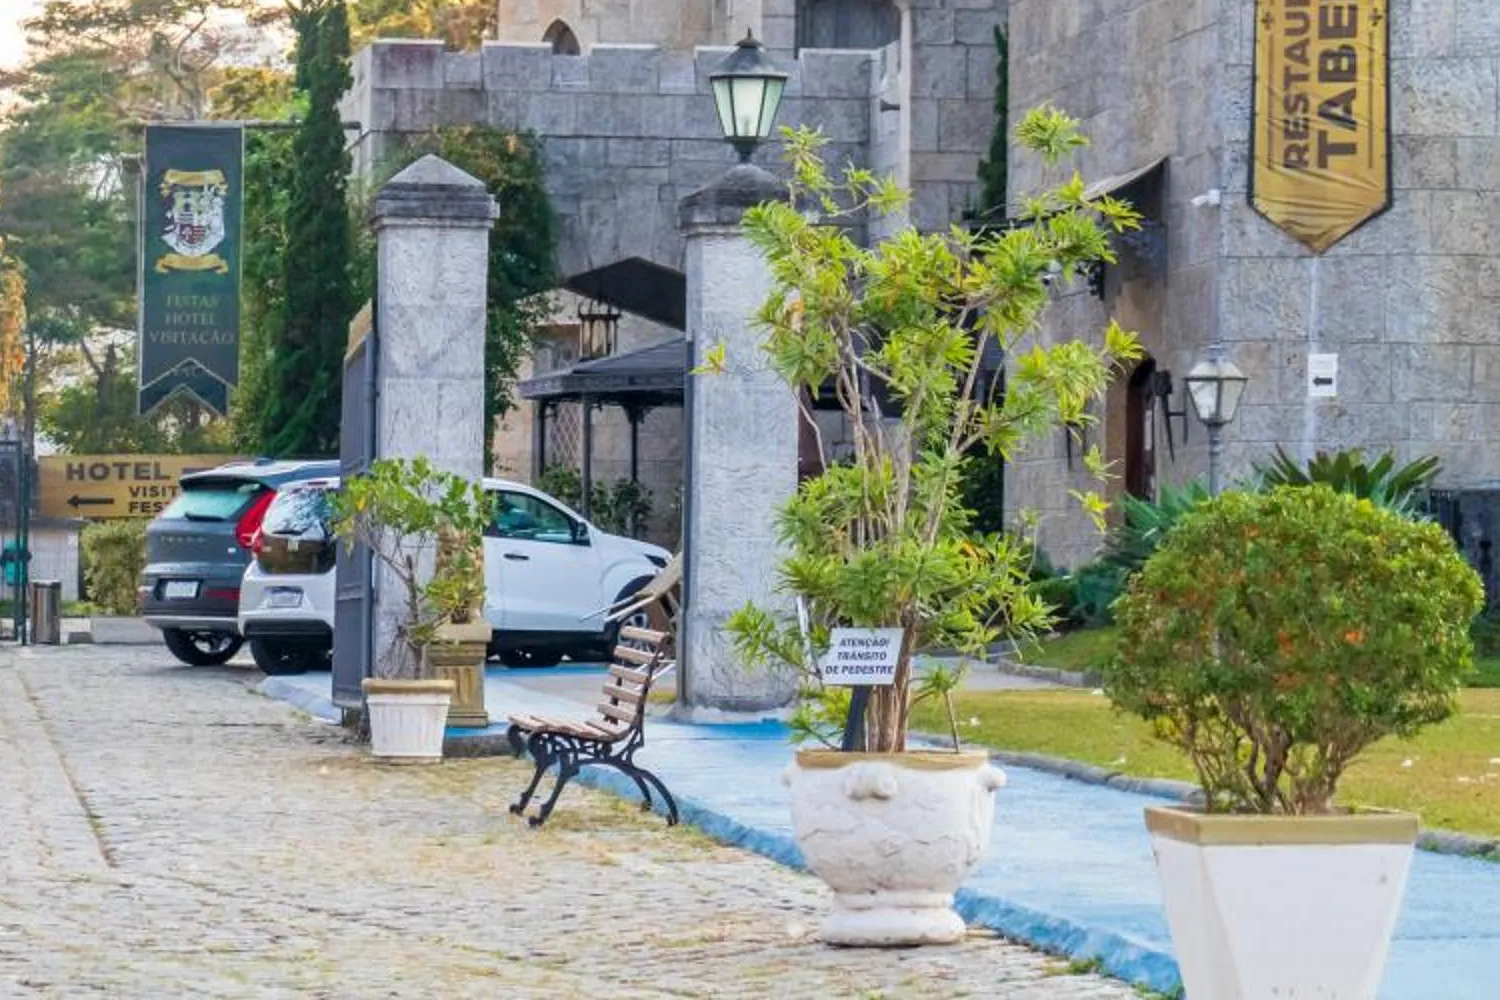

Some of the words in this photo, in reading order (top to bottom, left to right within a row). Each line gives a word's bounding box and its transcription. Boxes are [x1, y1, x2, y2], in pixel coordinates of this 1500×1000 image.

[165, 312, 215, 325] HOTEL
[149, 328, 235, 345] VISITAÇÃO
[66, 462, 171, 481] HOTEL
[128, 485, 181, 498] VISIT
[825, 665, 839, 675] DE
[842, 665, 894, 675] PEDESTRE
